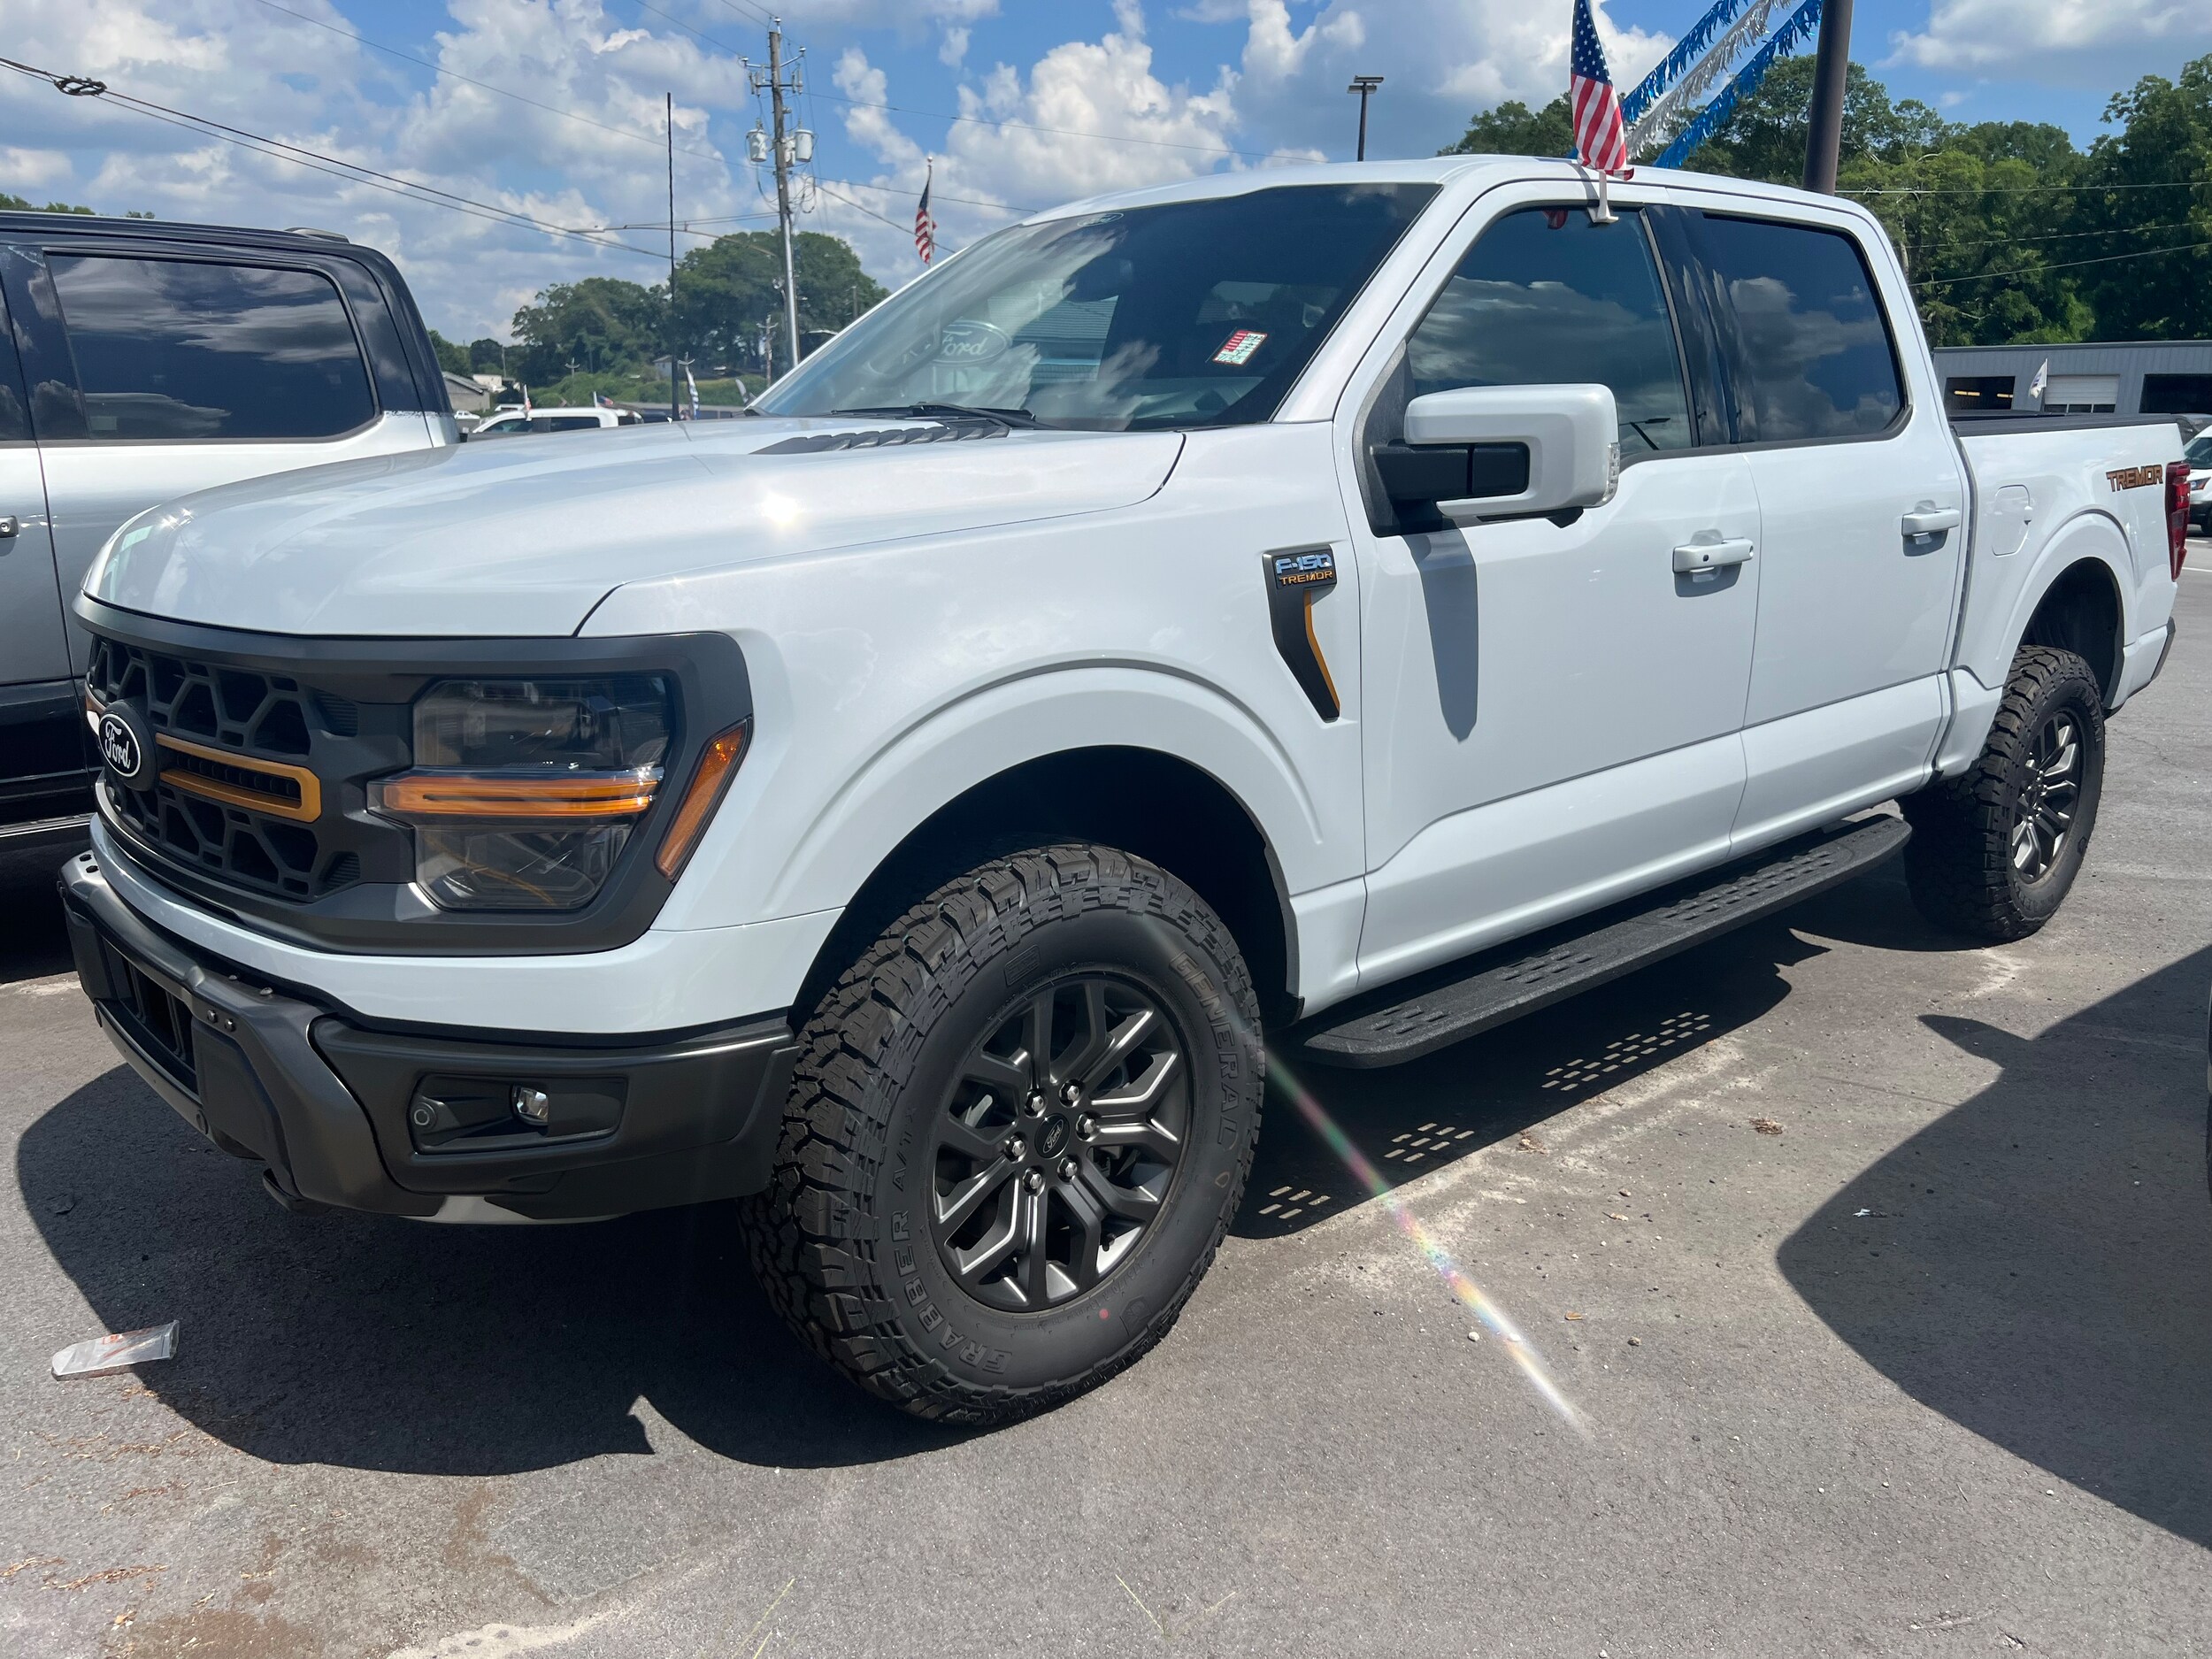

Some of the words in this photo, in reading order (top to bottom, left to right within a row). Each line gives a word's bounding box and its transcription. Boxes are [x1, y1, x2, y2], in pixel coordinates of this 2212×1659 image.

[942, 329, 987, 356] Ford
[2106, 465, 2163, 492] TREMOR
[1276, 554, 1333, 574] F-150
[1279, 570, 1333, 585] TREMOR
[105, 720, 131, 769] Ford
[1169, 950, 1240, 1149] GENERAL
[1047, 1125, 1061, 1148] Ford
[890, 1210, 1014, 1374] GRABBER
